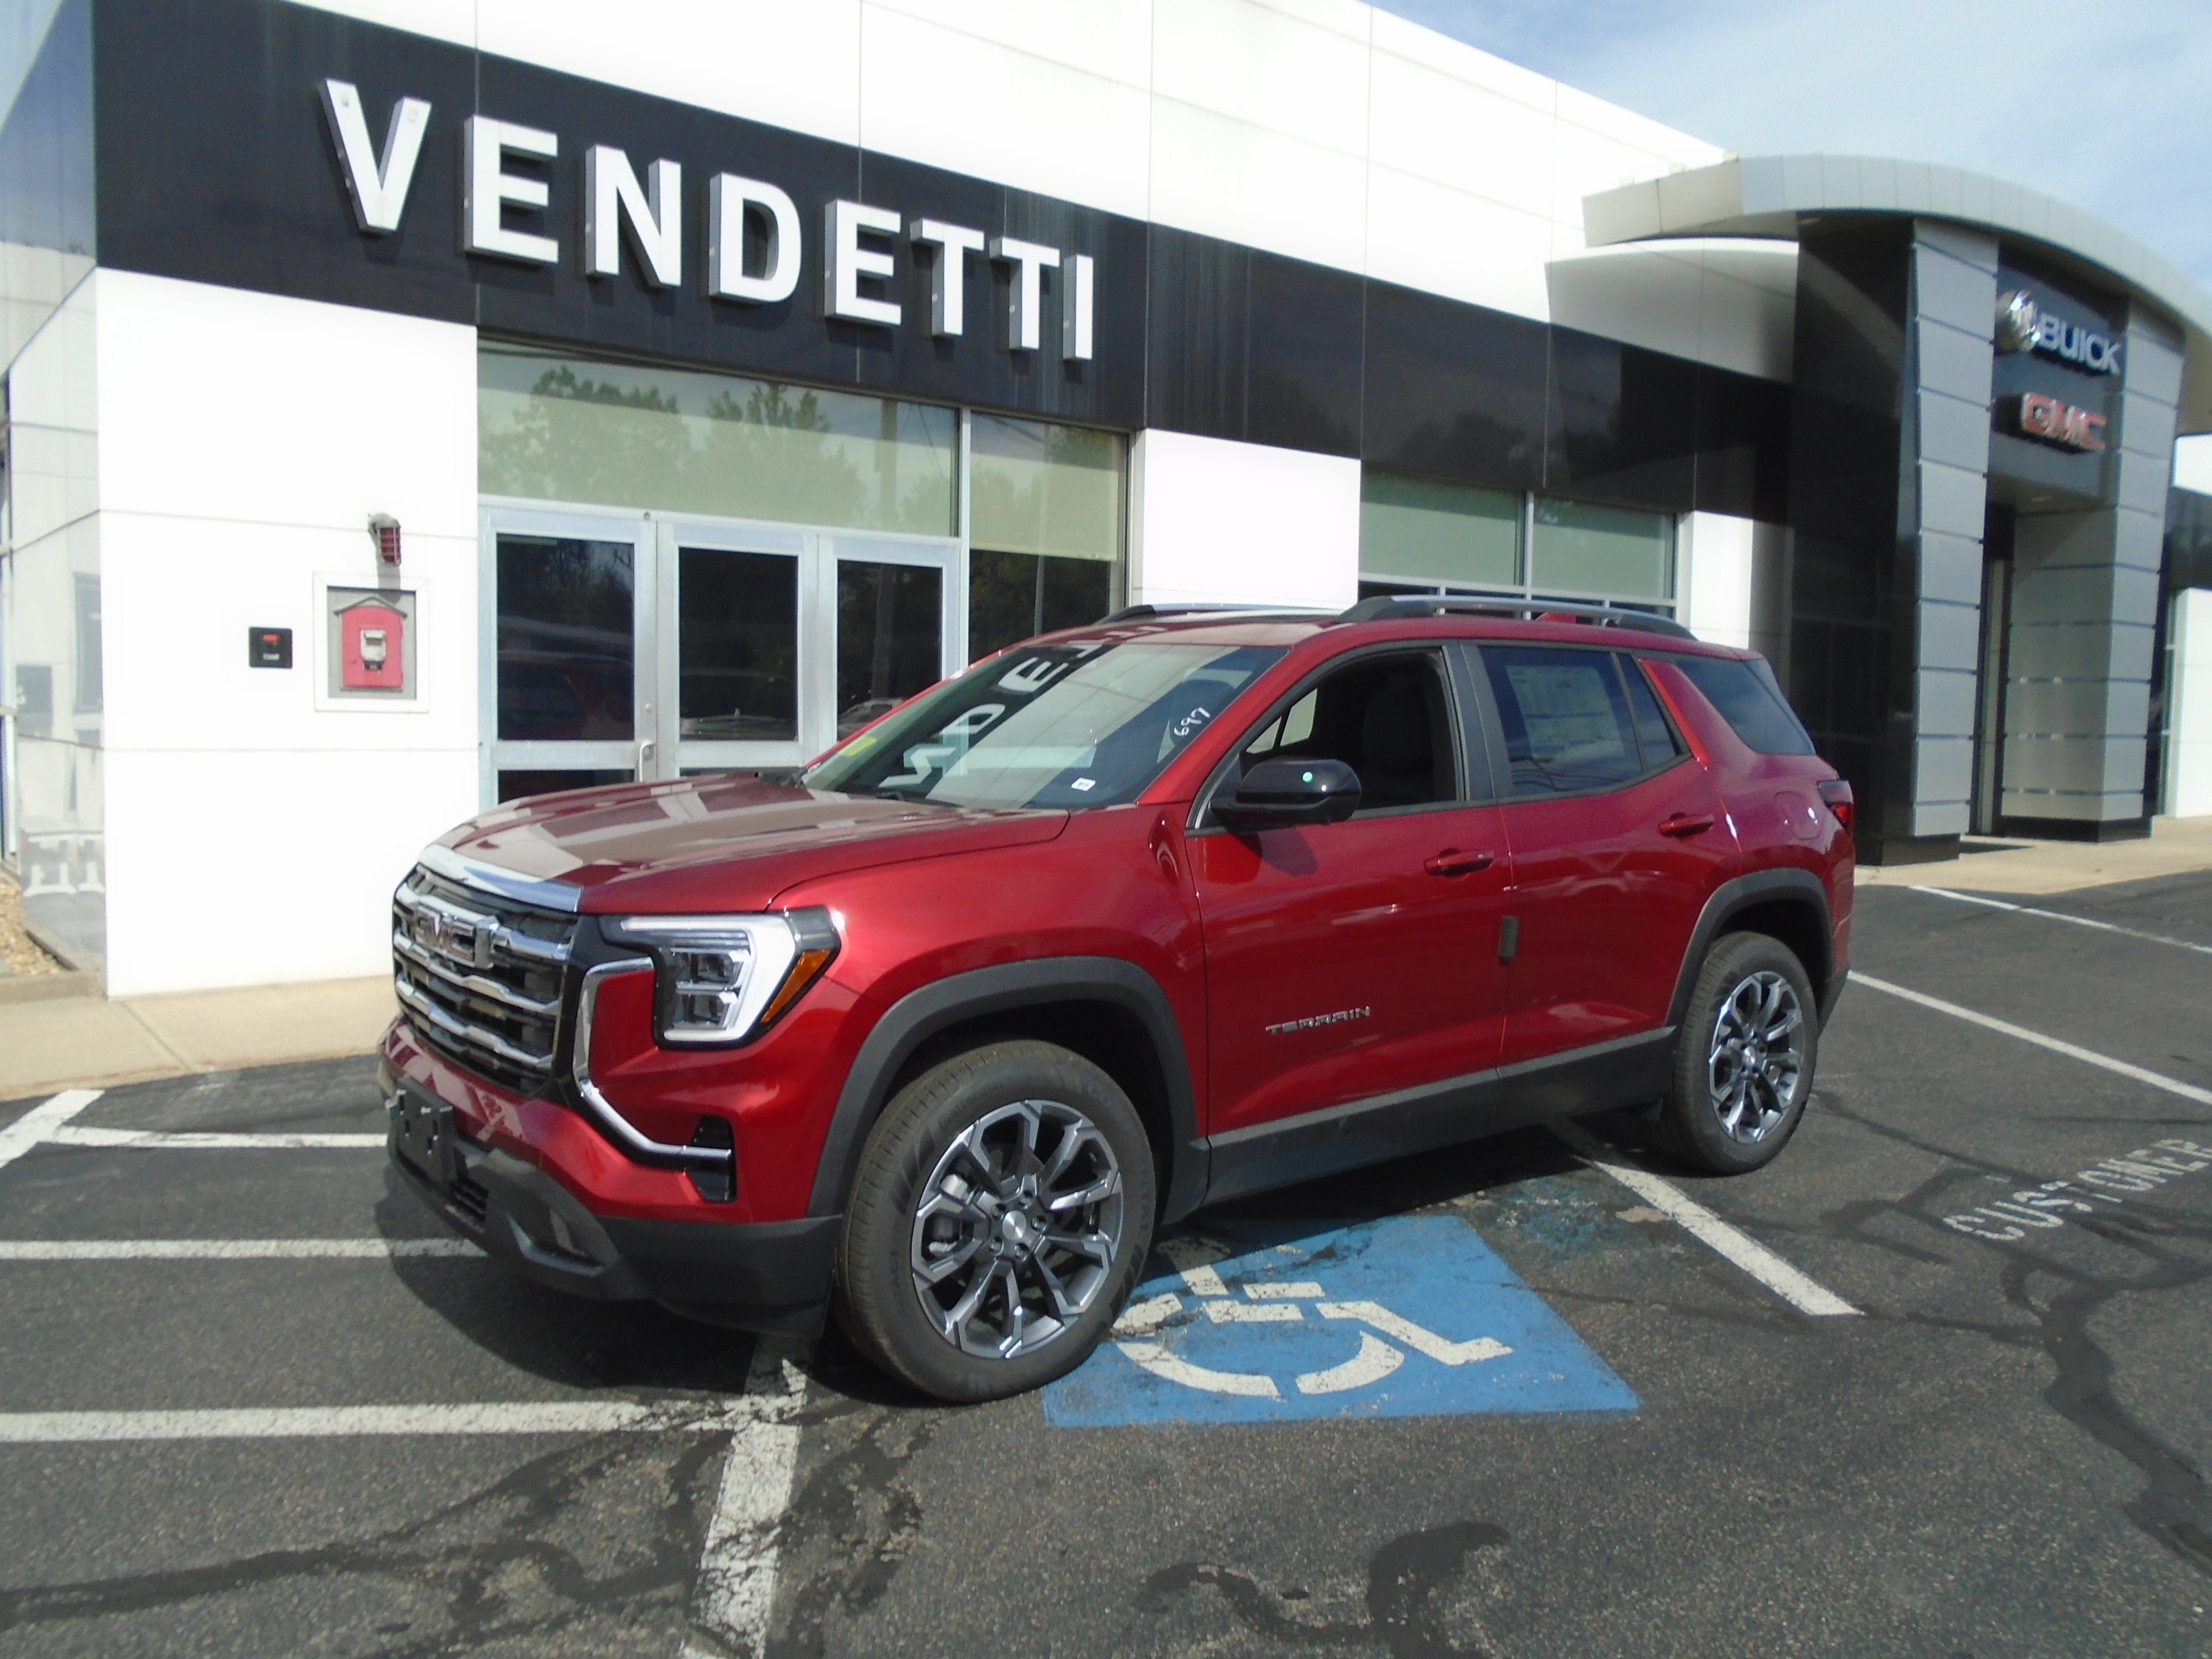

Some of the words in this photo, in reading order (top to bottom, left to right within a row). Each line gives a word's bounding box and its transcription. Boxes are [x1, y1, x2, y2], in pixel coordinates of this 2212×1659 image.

[320, 78, 1093, 362] VENDETTI
[2039, 312, 2121, 376] BUICK
[2020, 392, 2107, 452] GMC
[1173, 707, 1211, 736] 697
[412, 905, 483, 968] GMC
[1265, 1005, 1370, 1036] TERRAIN
